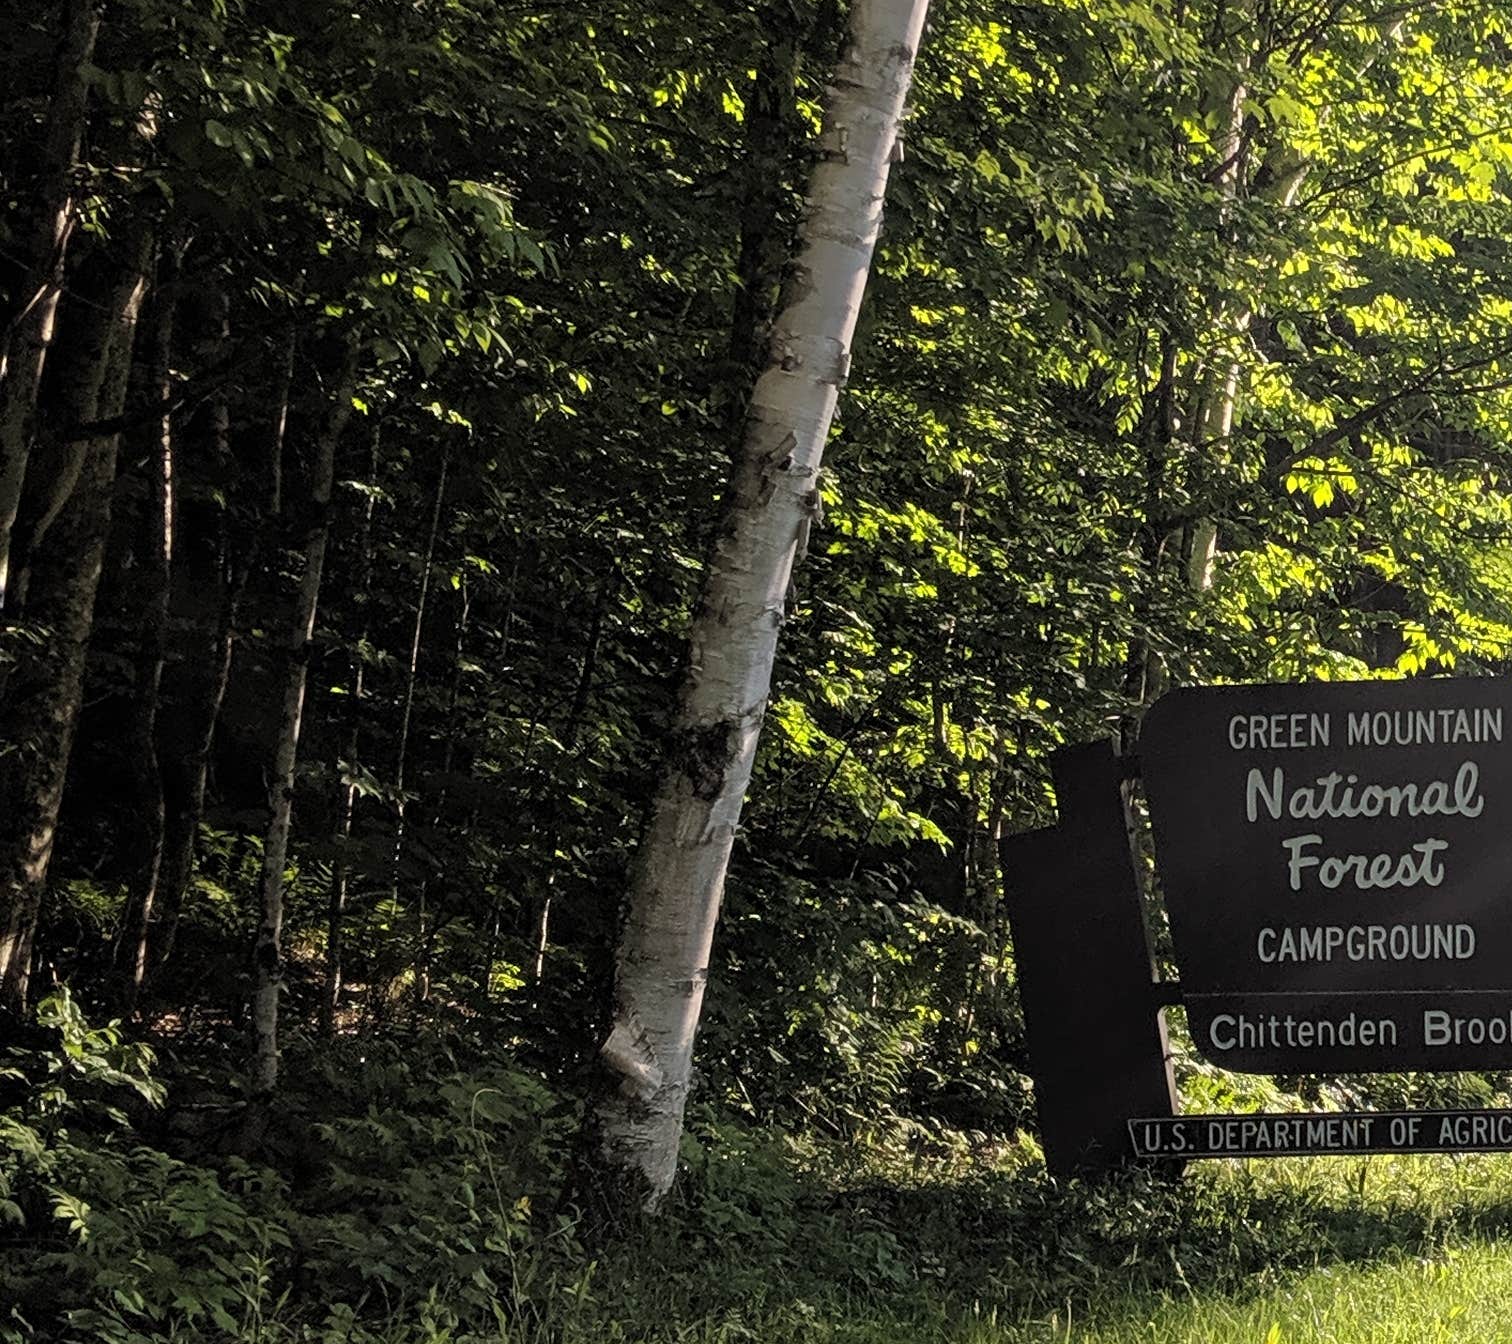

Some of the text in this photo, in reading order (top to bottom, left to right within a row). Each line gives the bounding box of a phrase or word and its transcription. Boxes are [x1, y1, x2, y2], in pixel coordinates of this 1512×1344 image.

[1227, 707, 1503, 751] GREEN MOUNTAIN
[1244, 761, 1484, 823] National
[1282, 834, 1449, 891] Forest
[1256, 924, 1476, 963] CAMPGROUND
[1209, 1012, 1397, 1051] Chittenden
[1144, 1122, 1195, 1152] U.S.
[1208, 1118, 1374, 1150] DEPARTMENT
[1389, 1117, 1422, 1146] OF
